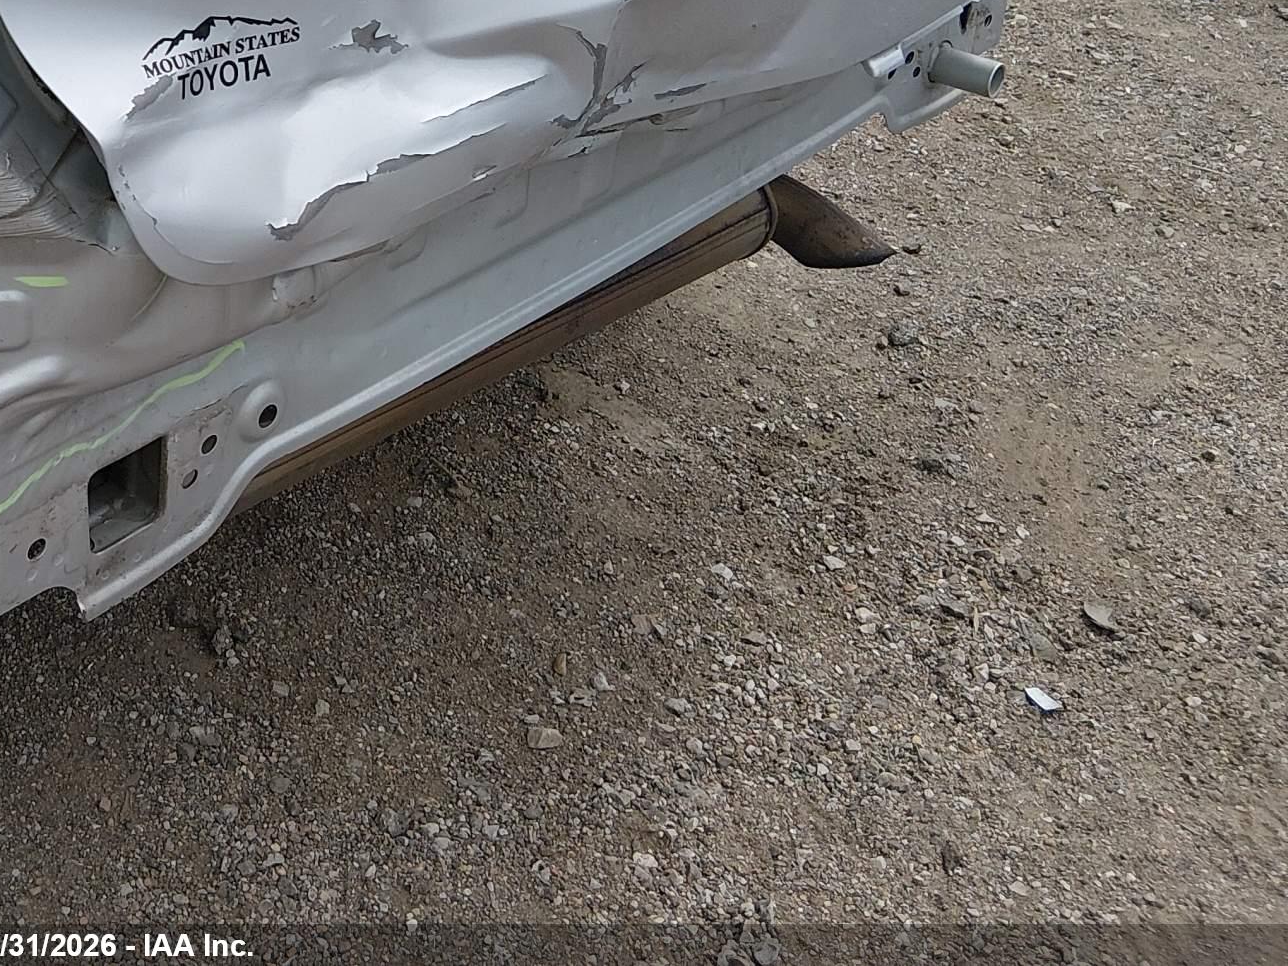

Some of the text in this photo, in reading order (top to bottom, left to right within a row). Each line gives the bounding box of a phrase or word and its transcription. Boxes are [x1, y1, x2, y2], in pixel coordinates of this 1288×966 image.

[143, 26, 301, 79] MOUNTAIN STATES
[177, 53, 272, 101] TOYOTA
